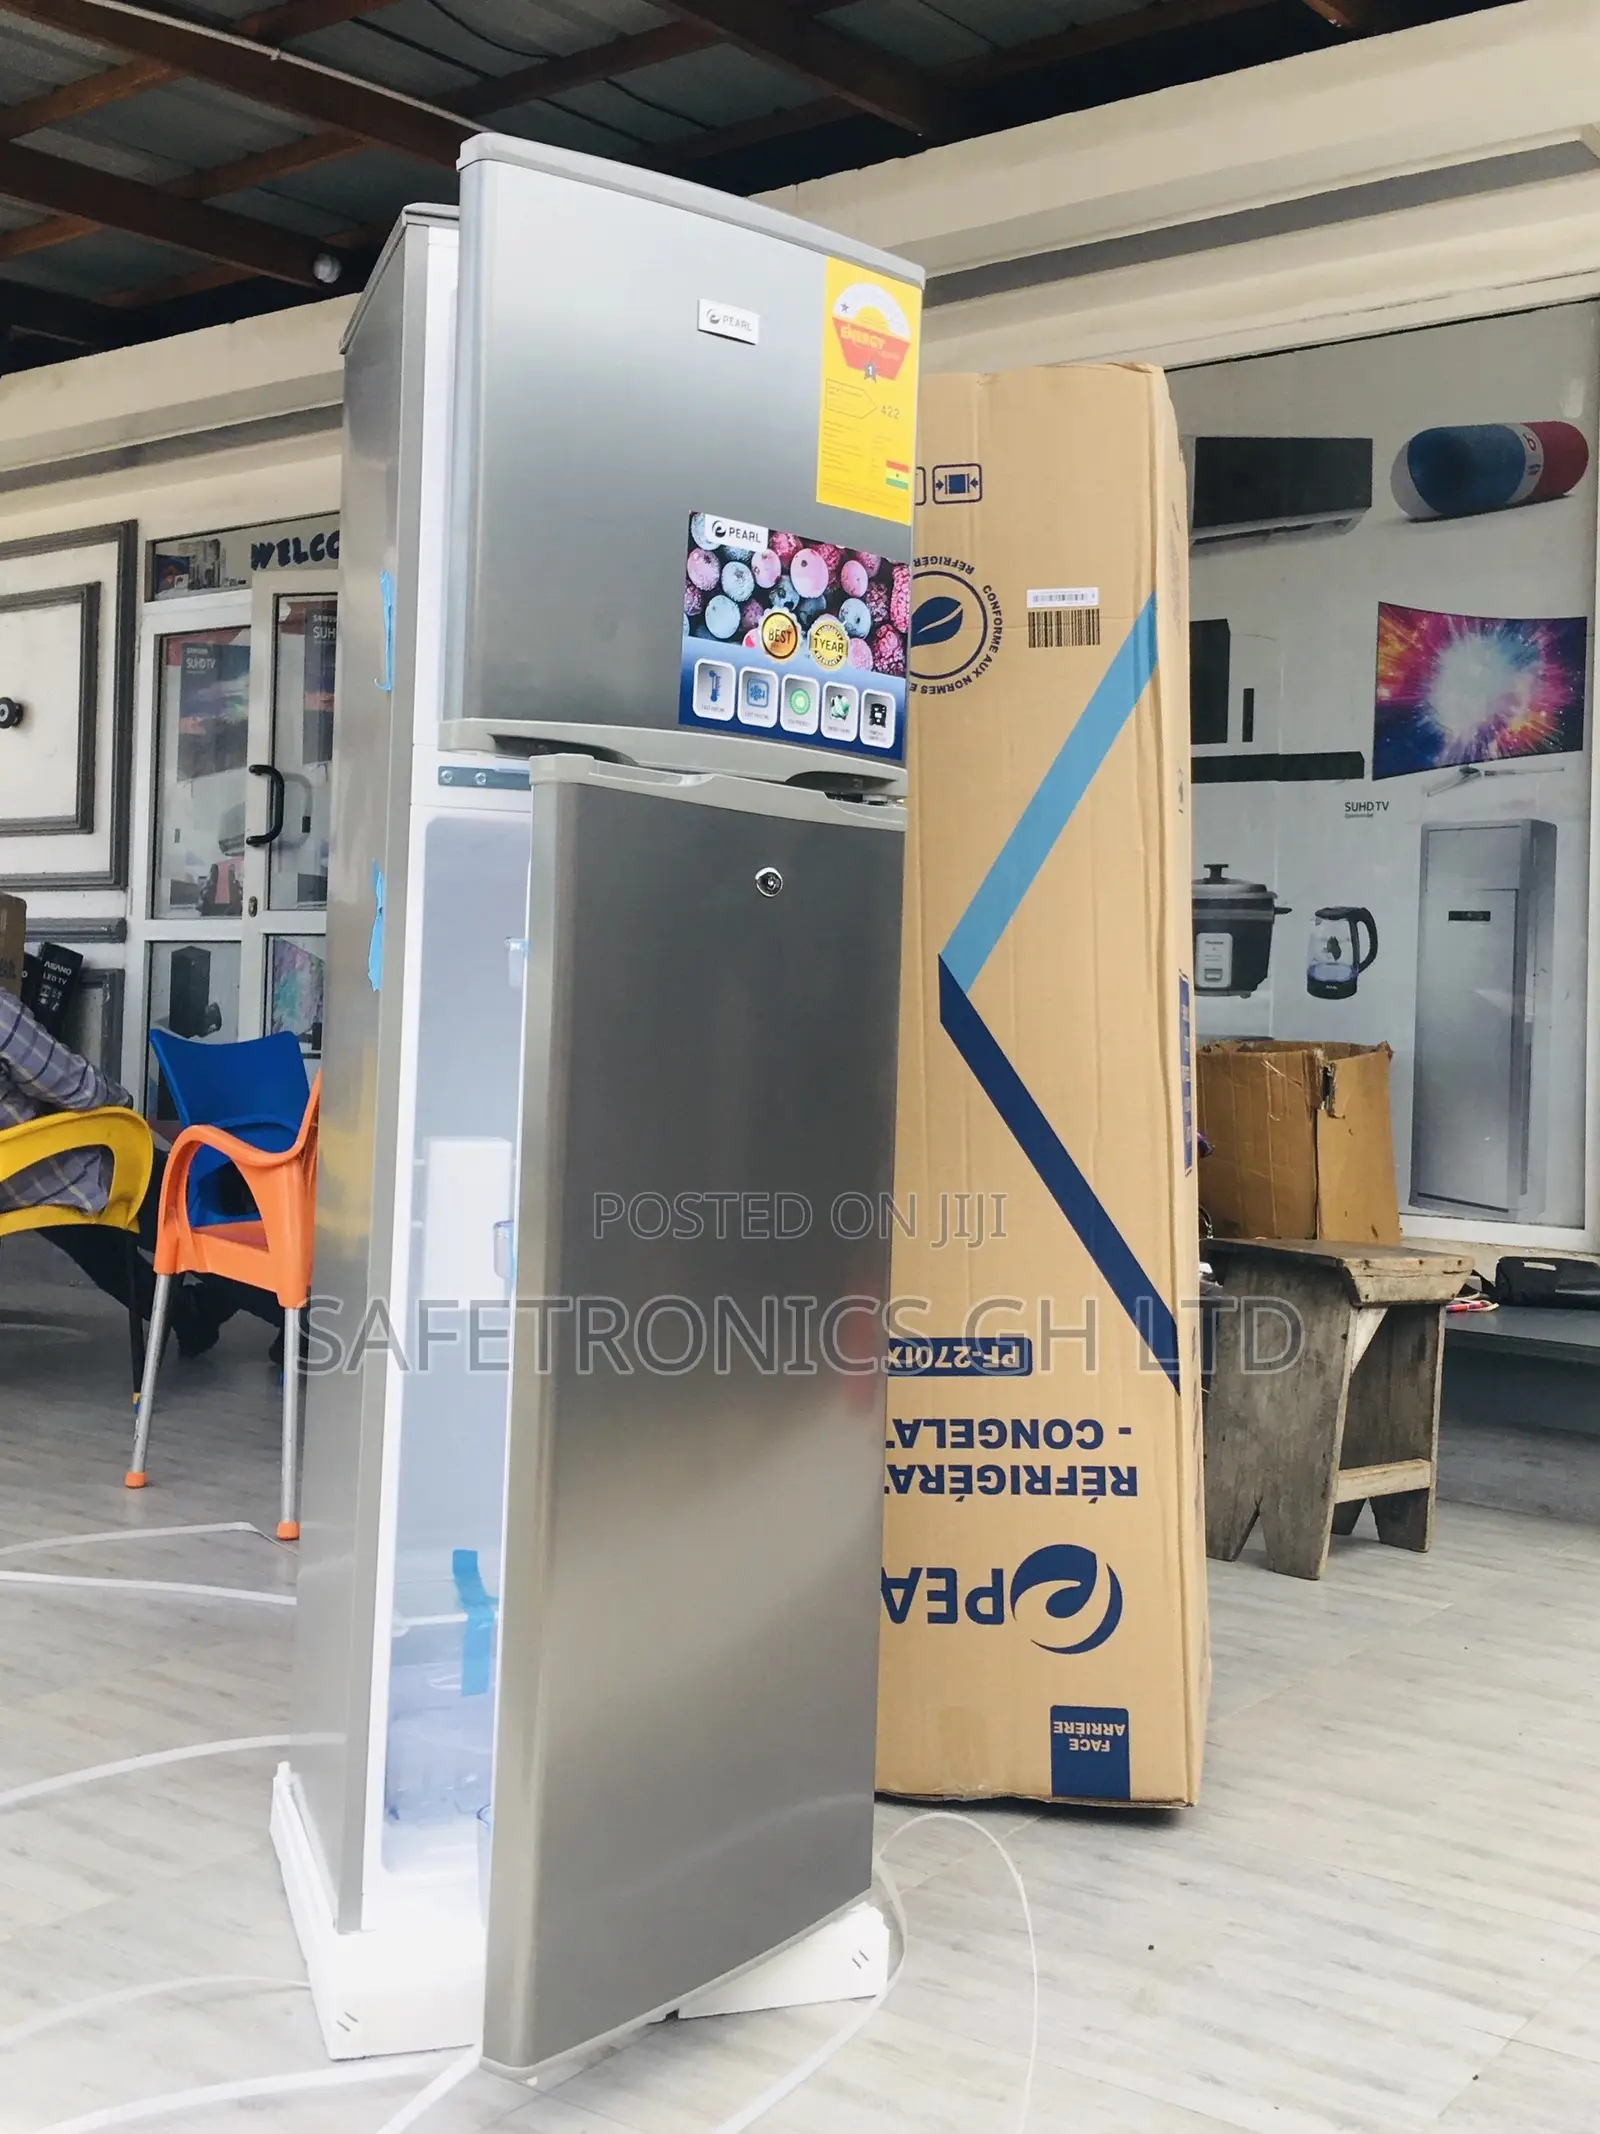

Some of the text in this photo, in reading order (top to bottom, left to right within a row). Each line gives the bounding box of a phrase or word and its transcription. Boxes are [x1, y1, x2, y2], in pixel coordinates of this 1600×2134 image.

[723, 315, 752, 331] PEARL
[880, 404, 900, 420] 422
[728, 526, 762, 544] PEARL
[982, 584, 1003, 654] CONFORME
[768, 628, 792, 645] BEST
[819, 638, 844, 653] YEAR
[972, 654, 993, 679] AUX
[920, 675, 973, 695] NORMES
[1344, 800, 1390, 812] SUHD TV
[43, 972, 68, 985] LED TV
[885, 1418, 1104, 1450] CONGELA
[884, 1464, 1138, 1505] RÉFRIGÉRA
[880, 1567, 1005, 1626] PEA
[1053, 1721, 1126, 1738] ARRIÈRE
[1068, 1738, 1111, 1753] FACE
